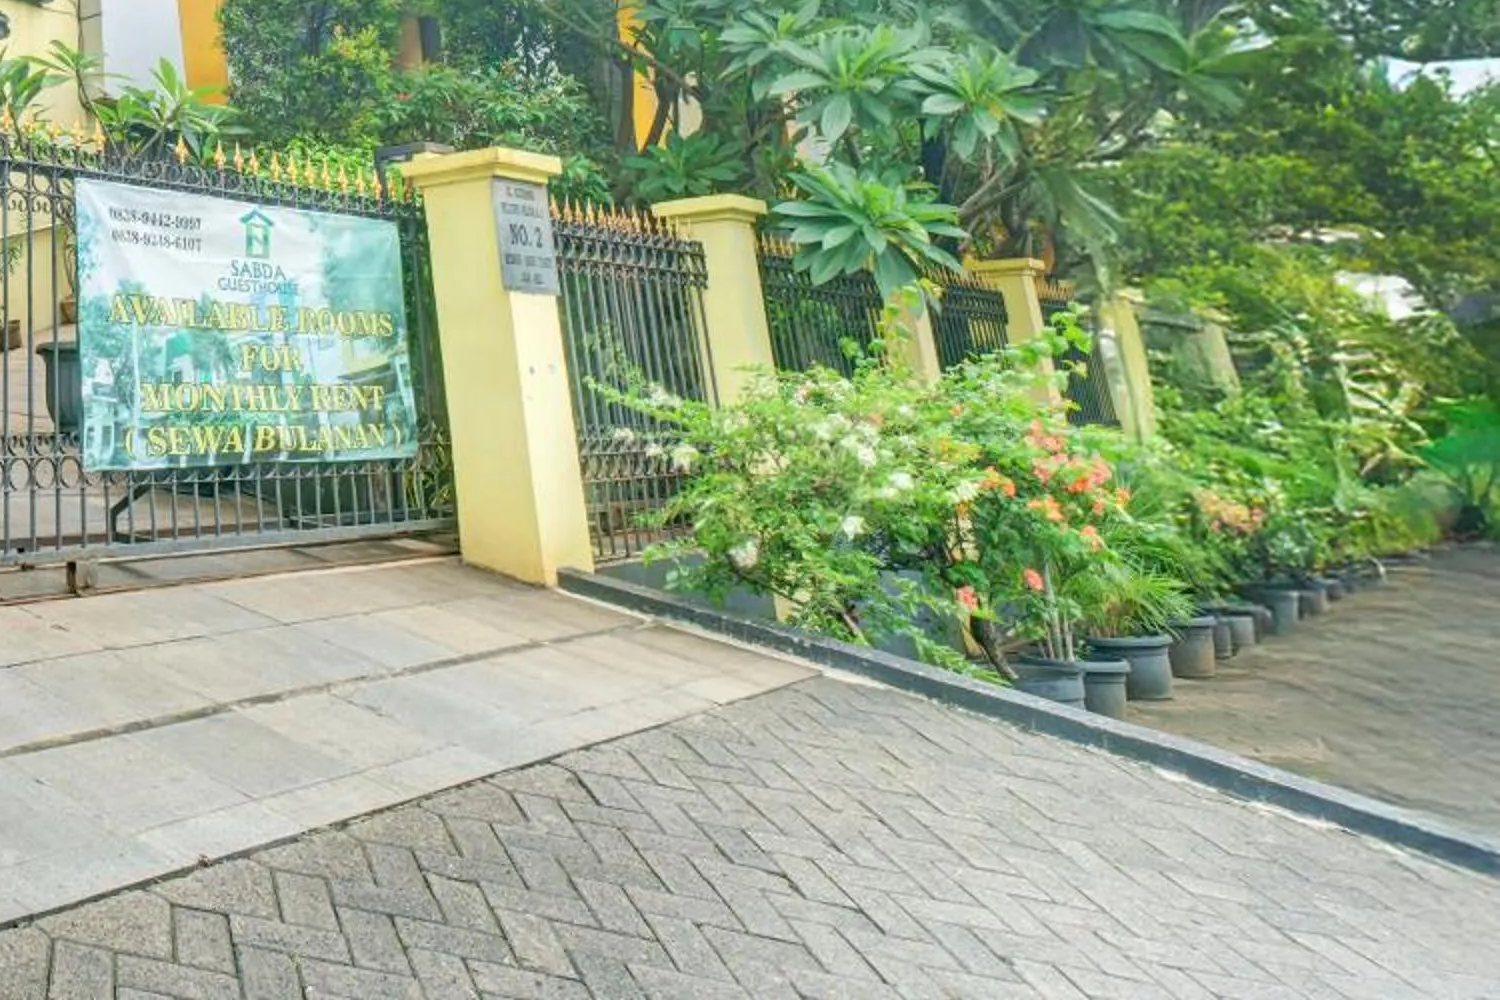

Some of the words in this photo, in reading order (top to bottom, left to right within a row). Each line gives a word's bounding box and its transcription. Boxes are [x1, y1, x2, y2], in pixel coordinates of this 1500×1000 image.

[509, 223, 533, 247] NO.
[231, 260, 287, 281] SABDA
[217, 277, 299, 295] GUESTHOUSE
[109, 293, 290, 333] AVAILABLE
[297, 305, 394, 338] ROOMS
[240, 344, 304, 373] FOR
[140, 382, 304, 413] MONTHLY
[309, 384, 386, 412] RENT
[146, 424, 246, 456] SEWA
[254, 422, 387, 452] BULANAN
